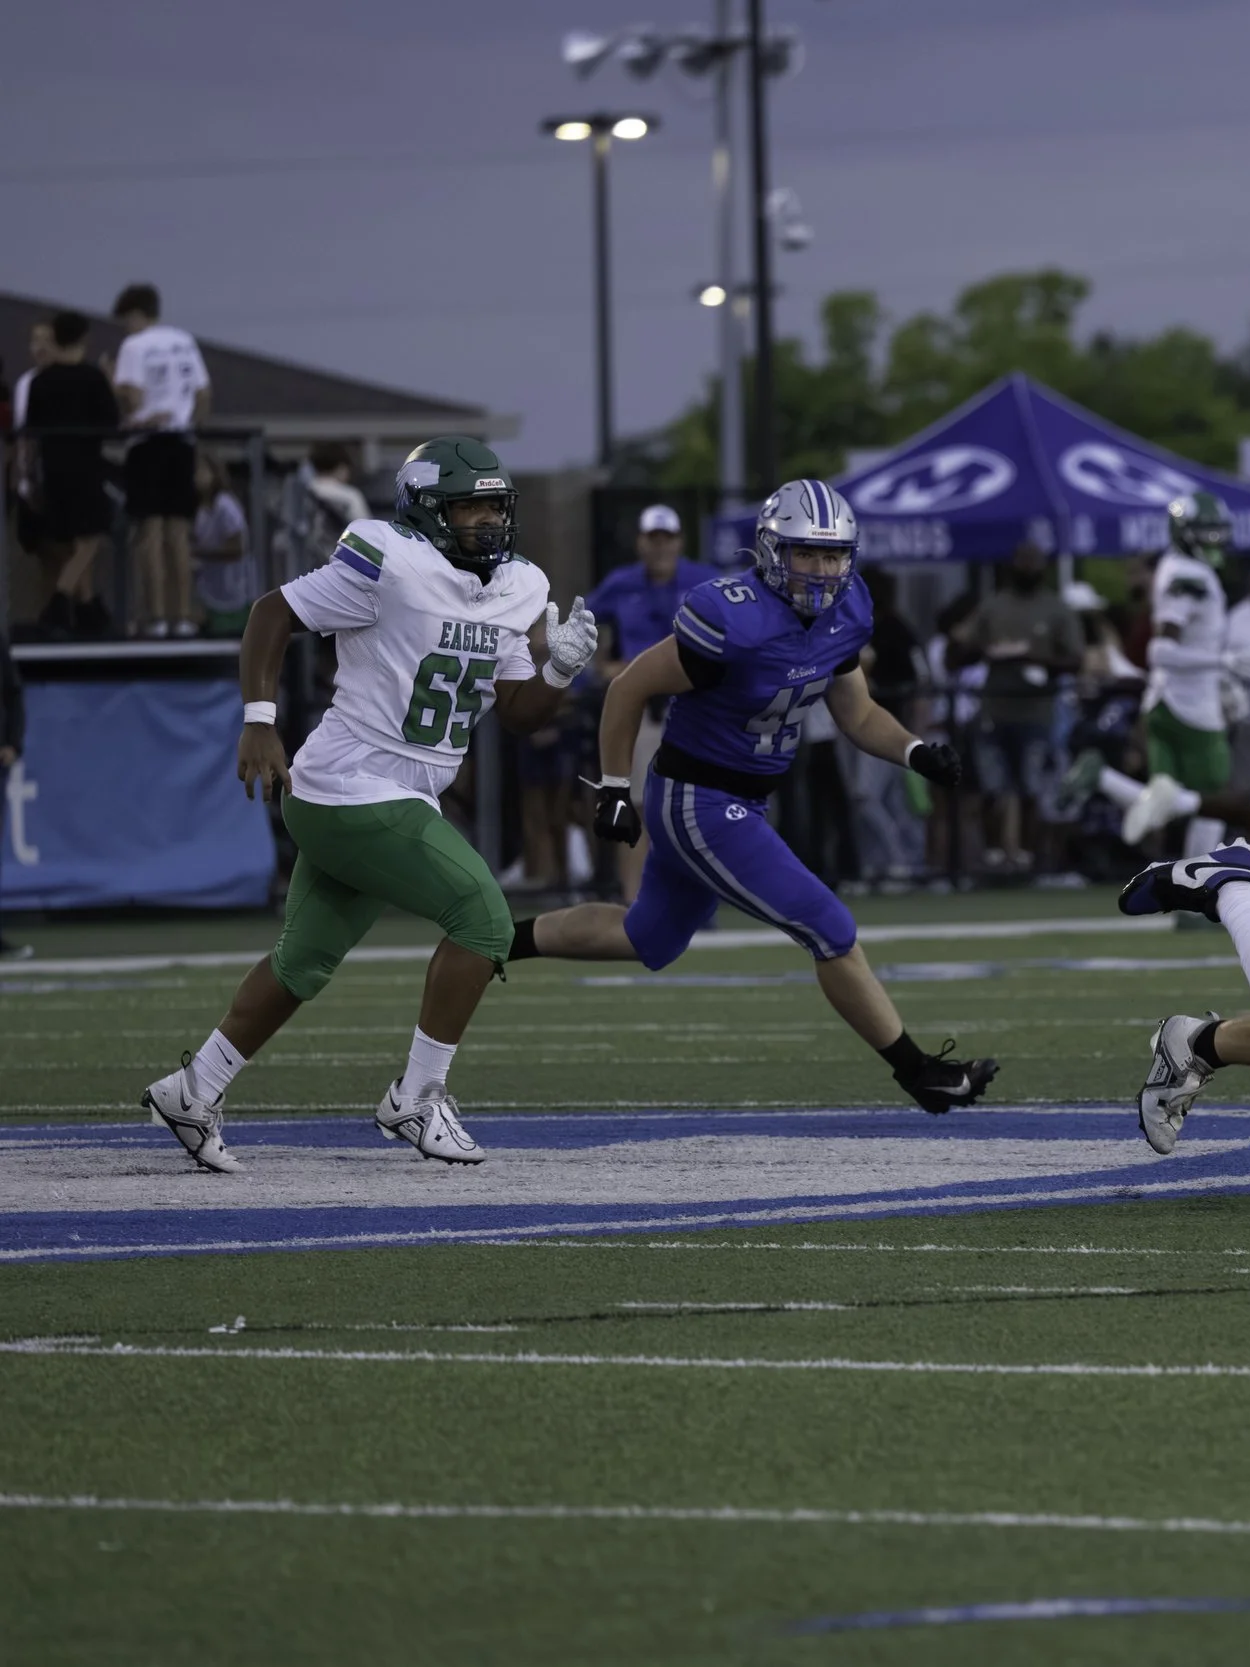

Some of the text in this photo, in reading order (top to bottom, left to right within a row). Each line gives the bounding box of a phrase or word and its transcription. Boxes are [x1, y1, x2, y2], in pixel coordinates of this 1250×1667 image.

[438, 621, 500, 655] EAGLES
[402, 652, 499, 749] 65
[744, 677, 829, 756] 45
